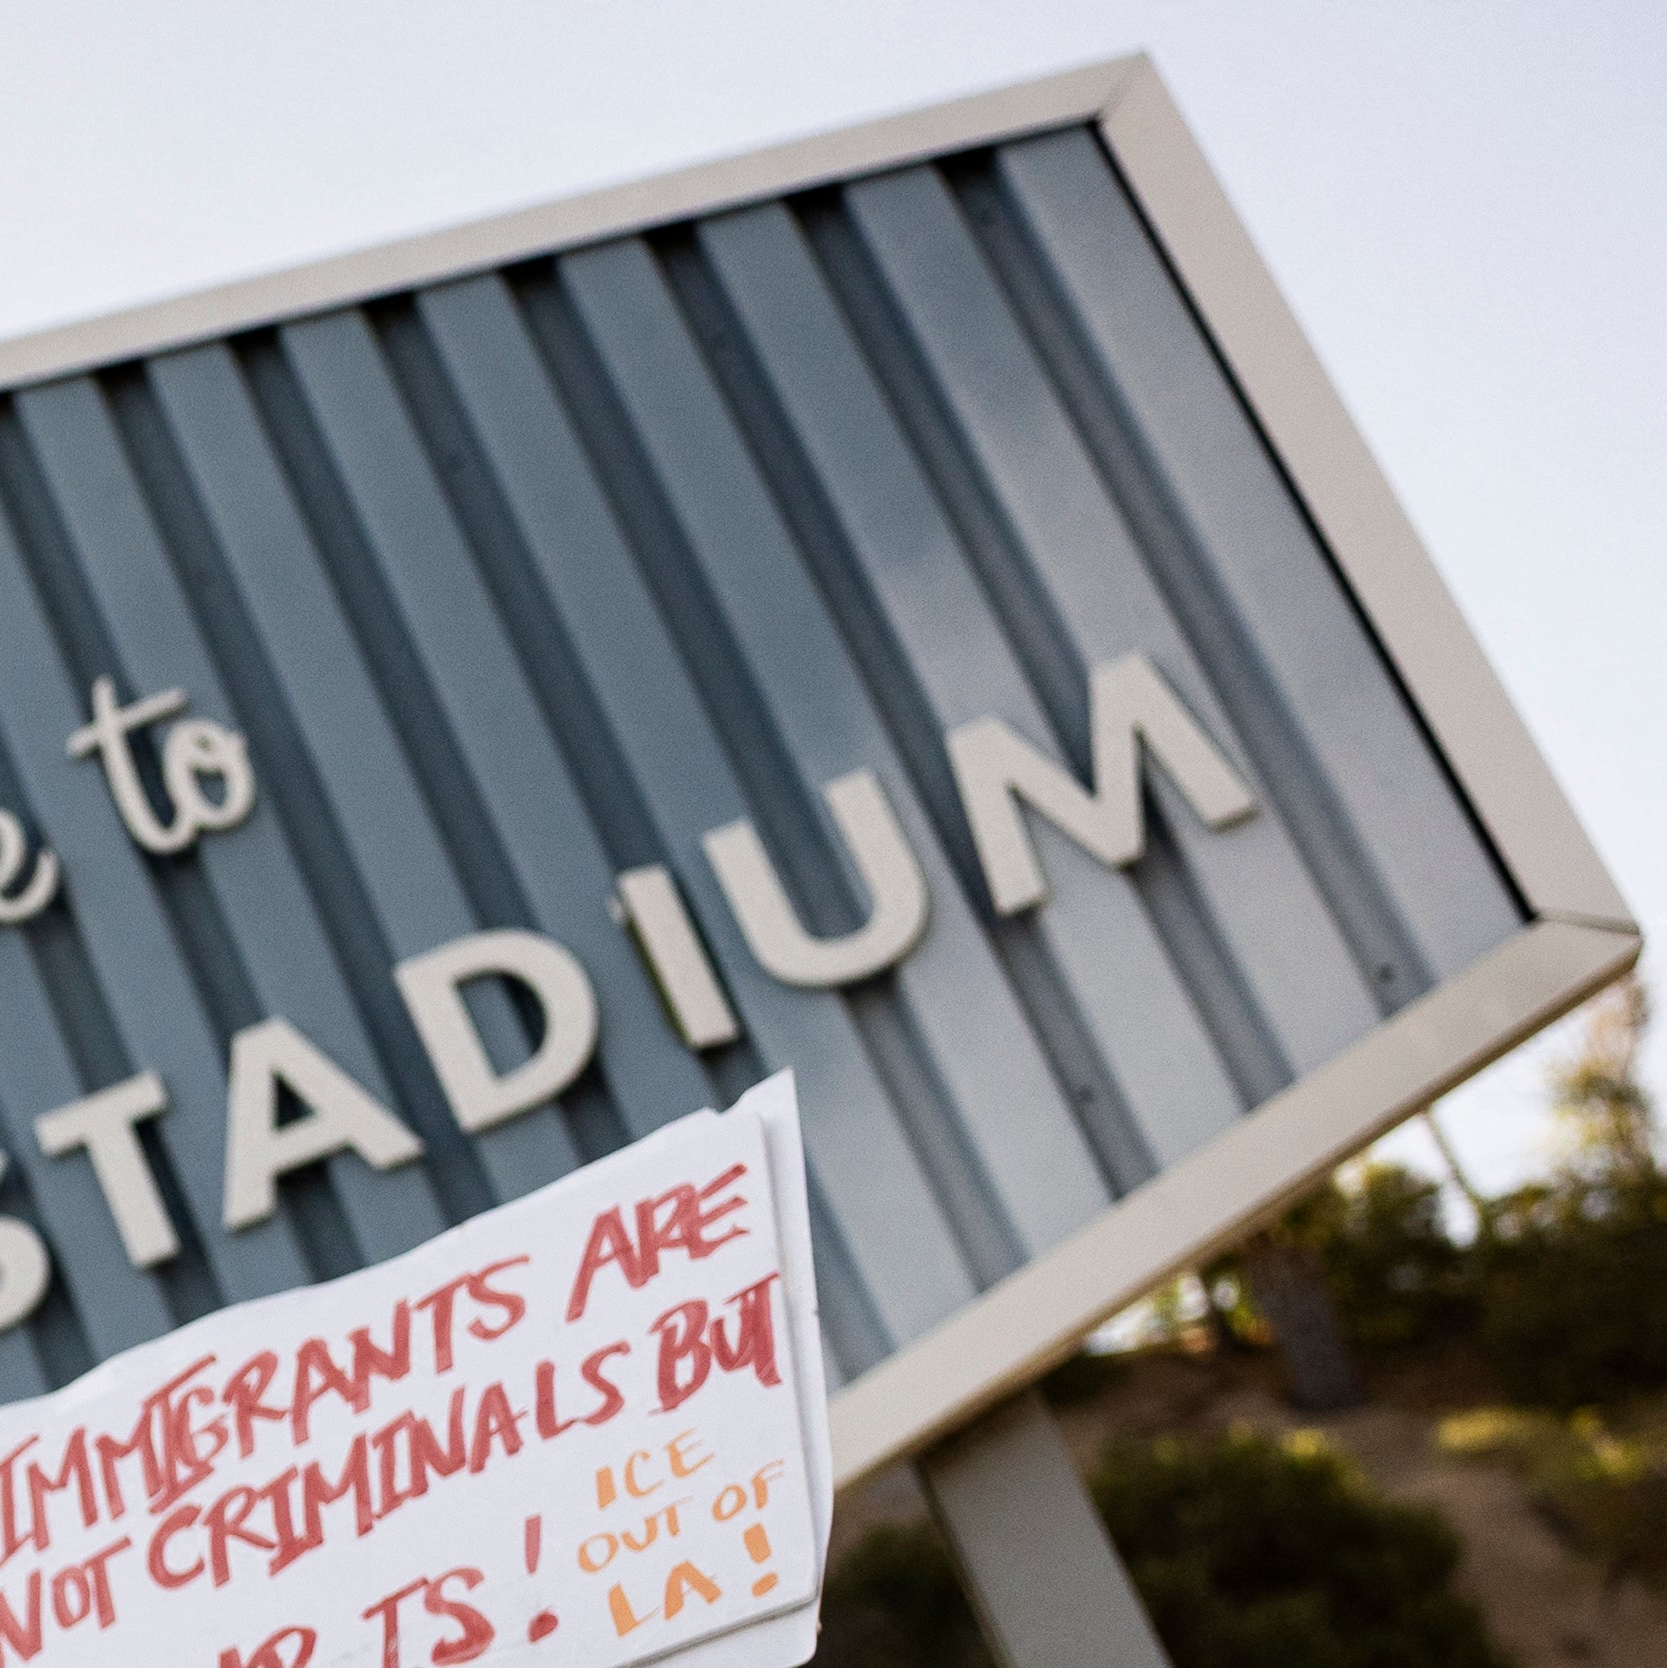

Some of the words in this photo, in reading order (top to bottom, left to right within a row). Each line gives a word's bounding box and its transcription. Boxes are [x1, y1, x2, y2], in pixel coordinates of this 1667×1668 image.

[66, 674, 257, 853] to
[565, 1163, 748, 1323] ARE
[147, 1341, 630, 1590] CRIMINALS
[647, 1273, 783, 1416] BUT
[595, 1427, 714, 1511] ICE
[577, 1495, 695, 1574] OUT
[712, 1458, 786, 1522] OF
